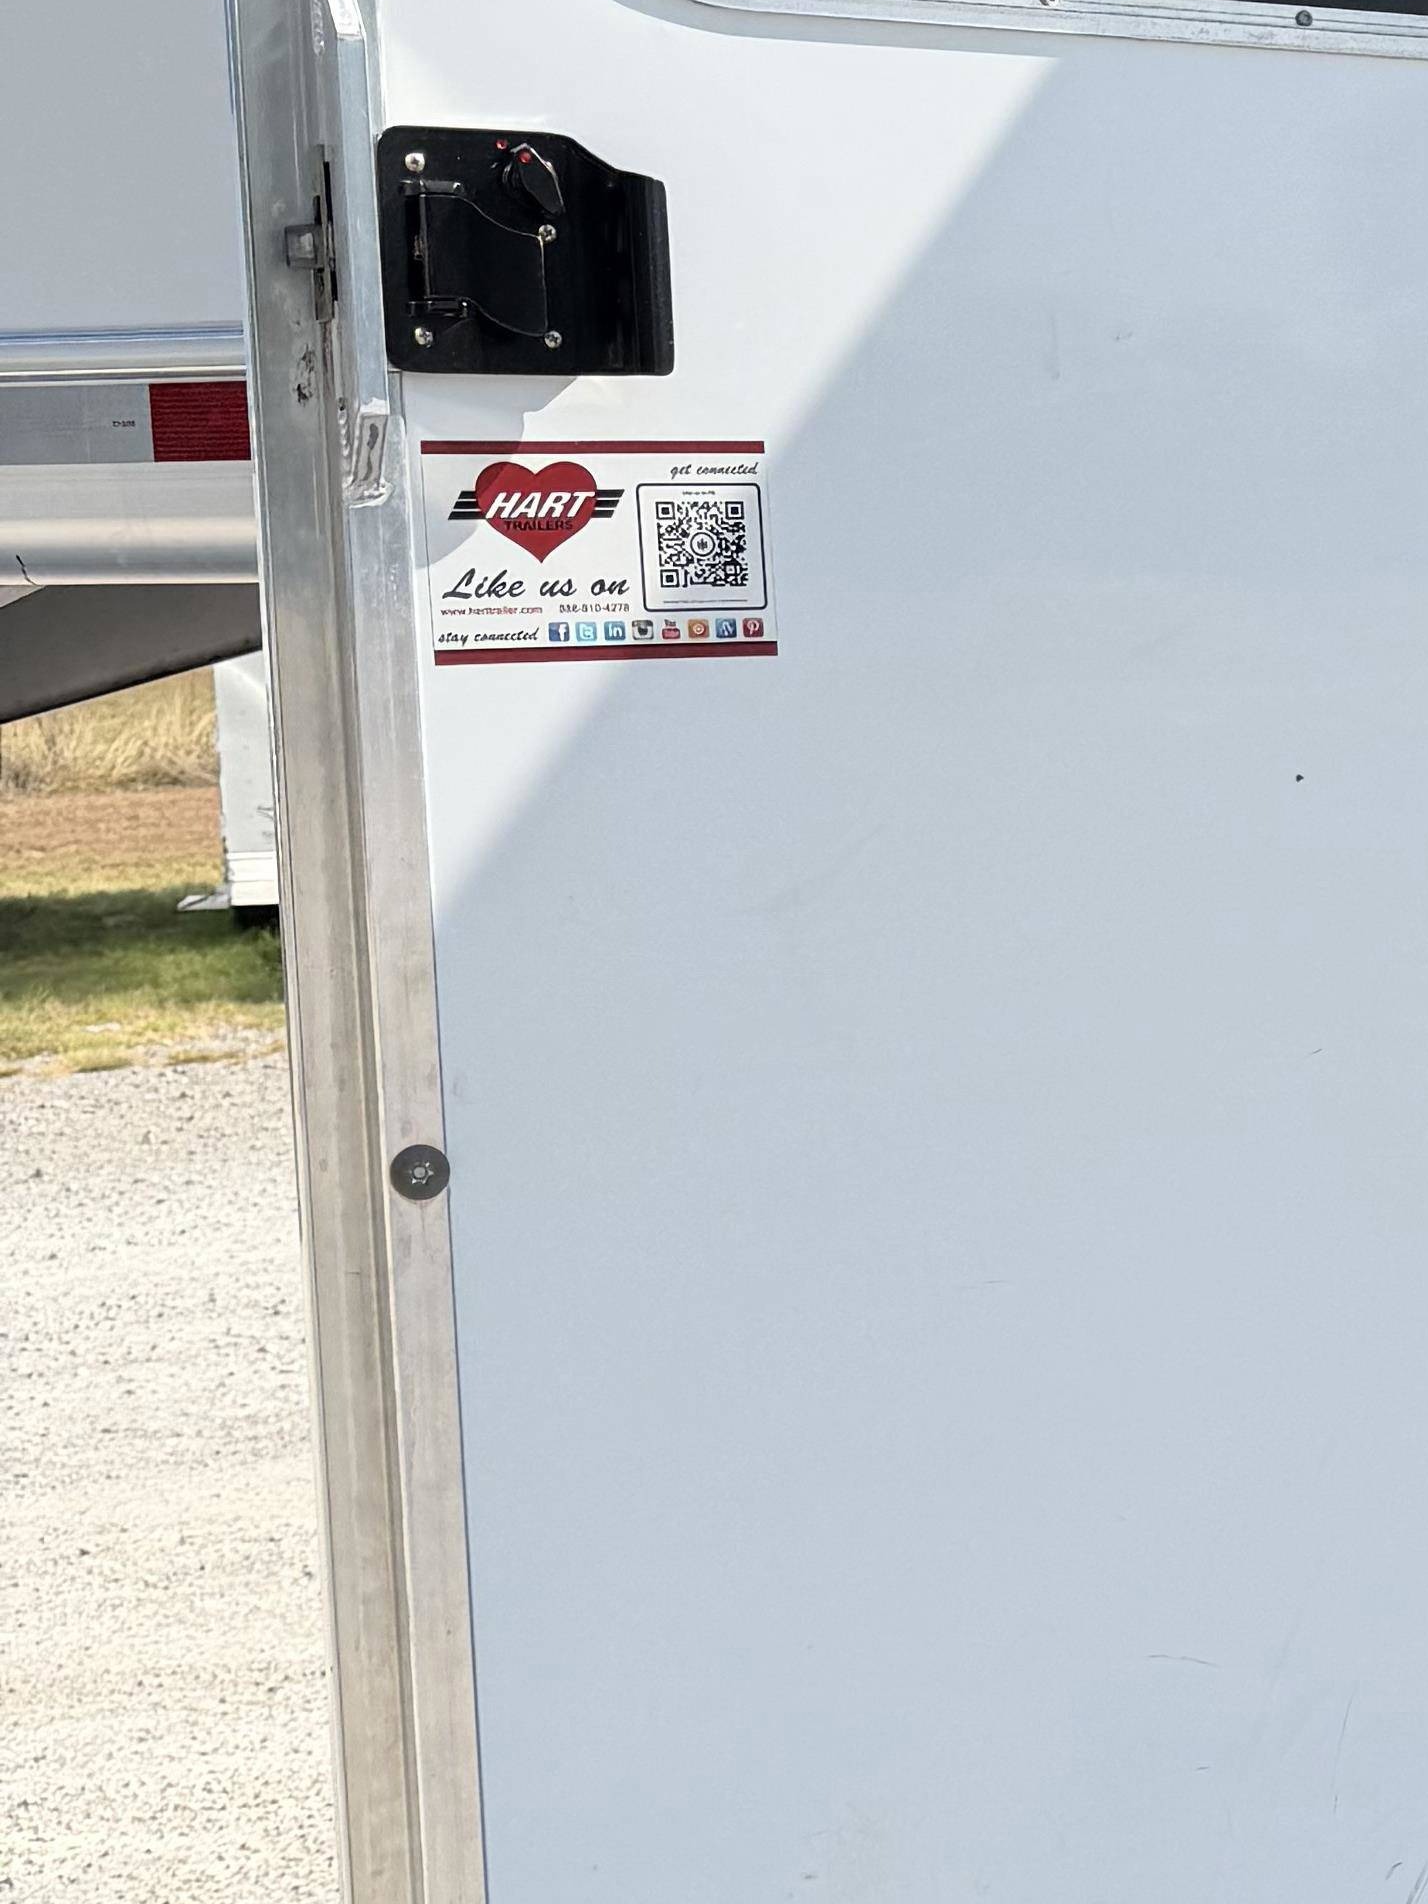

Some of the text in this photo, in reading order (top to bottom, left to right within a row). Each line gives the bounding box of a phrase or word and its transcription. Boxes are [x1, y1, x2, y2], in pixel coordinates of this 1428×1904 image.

[670, 462, 759, 479] get connected
[485, 491, 596, 519] HART
[504, 520, 573, 531] TRAILERS
[442, 568, 630, 599] Like us on
[438, 627, 540, 645] stay connected
